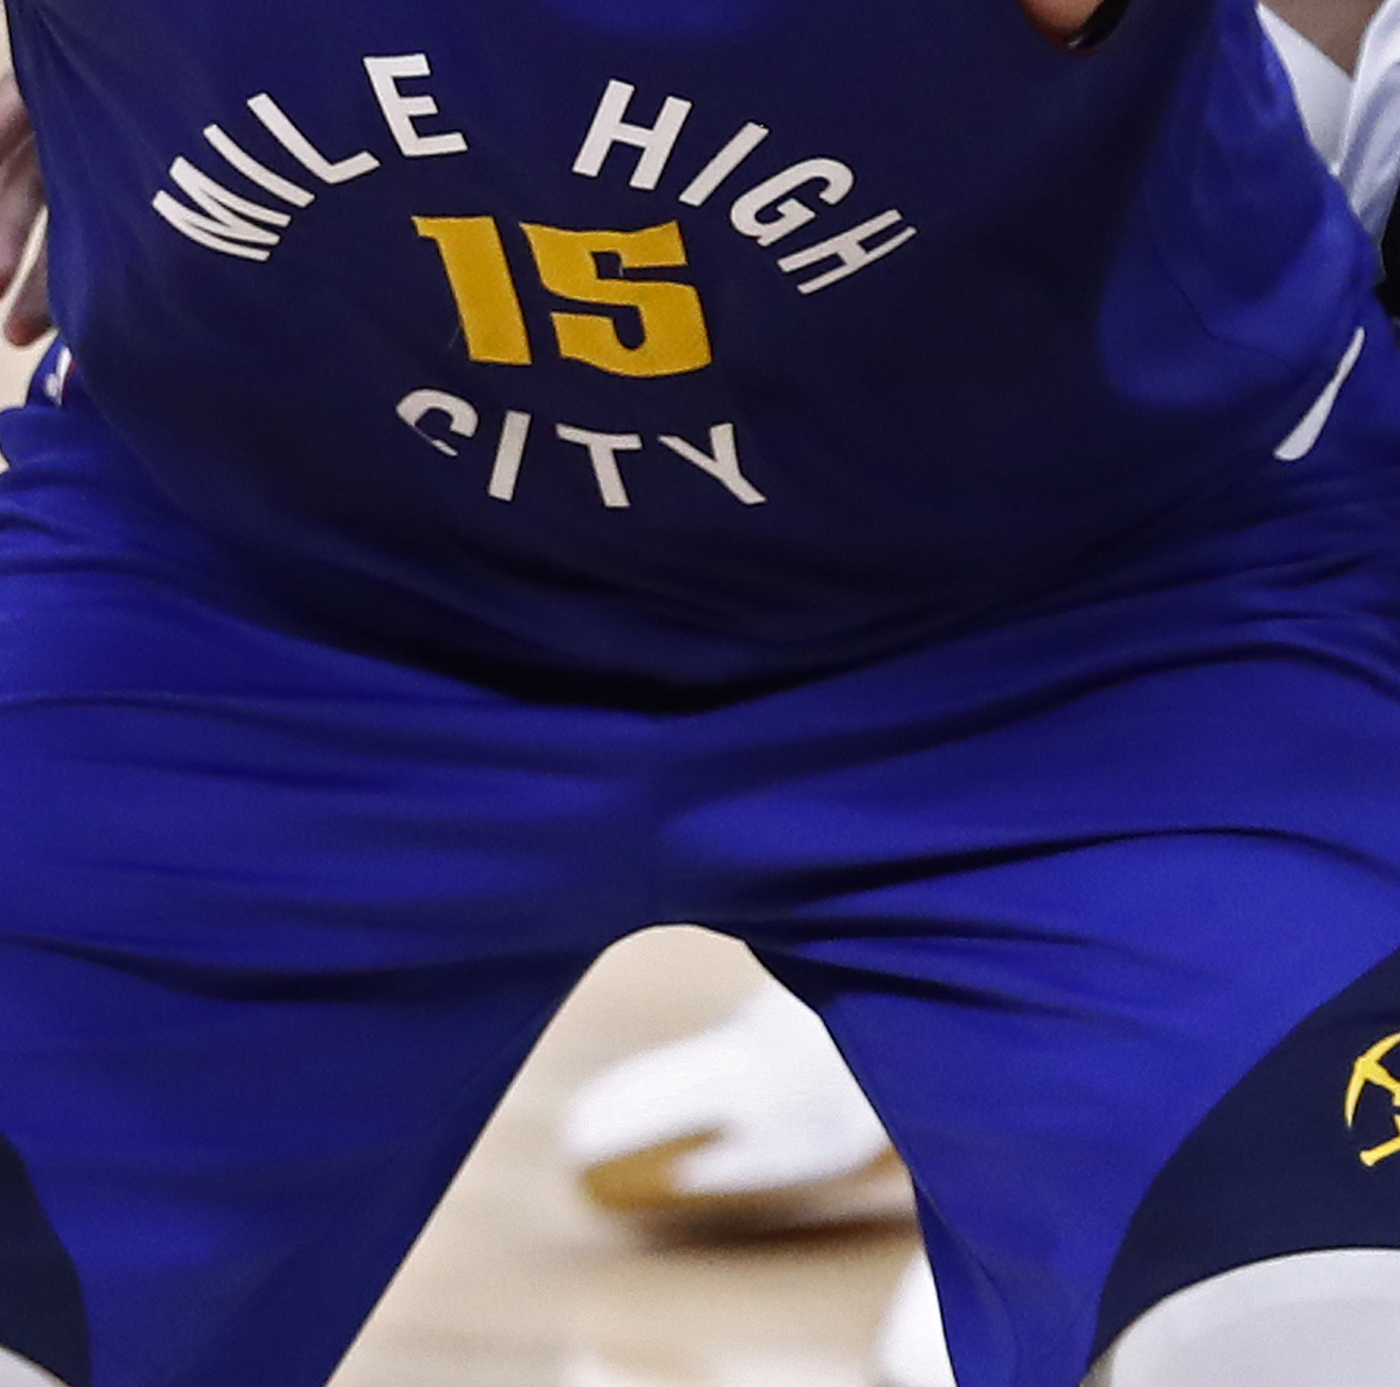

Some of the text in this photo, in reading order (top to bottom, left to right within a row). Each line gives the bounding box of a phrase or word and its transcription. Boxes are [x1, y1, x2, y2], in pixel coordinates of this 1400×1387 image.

[152, 53, 917, 294] MILE HIGH
[411, 215, 713, 378] 15
[396, 388, 766, 508] CITY
